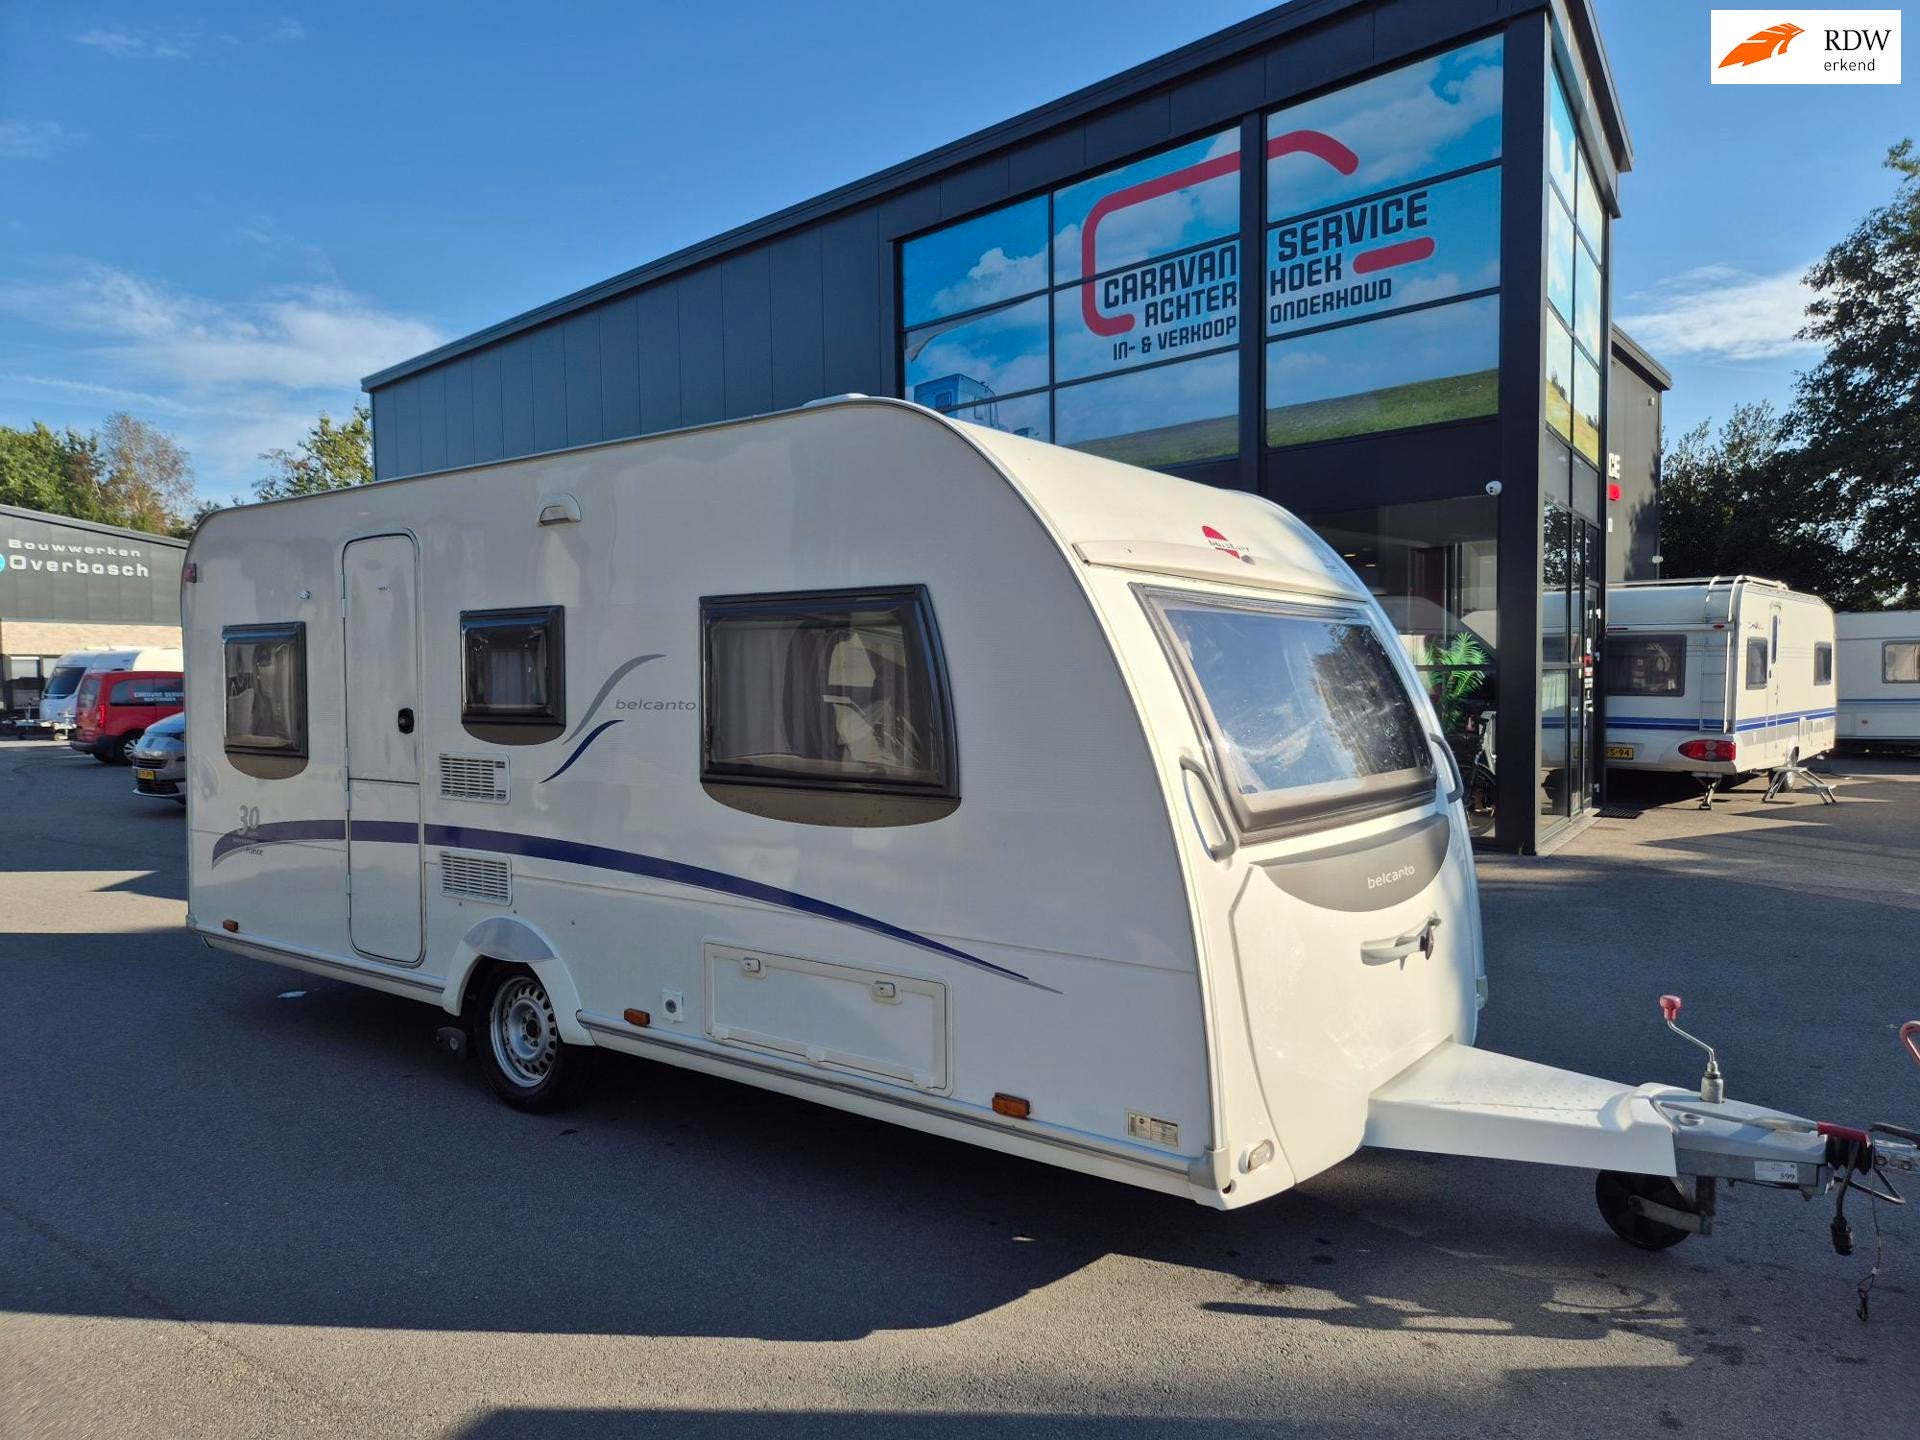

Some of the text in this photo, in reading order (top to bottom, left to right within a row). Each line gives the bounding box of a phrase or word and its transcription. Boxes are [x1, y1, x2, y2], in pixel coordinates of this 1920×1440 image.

[1104, 190, 1428, 309] CARAVAN SERVICE
[1145, 253, 1342, 328] ACHTER HOEK
[1113, 278, 1392, 361] IN- & VERKOOP ONDERHOUD
[8, 538, 141, 558] Bouwwerken
[9, 554, 149, 577] Overbosch
[615, 698, 697, 711] belcanto
[238, 804, 260, 836] 30
[1367, 865, 1416, 889] belcanto
